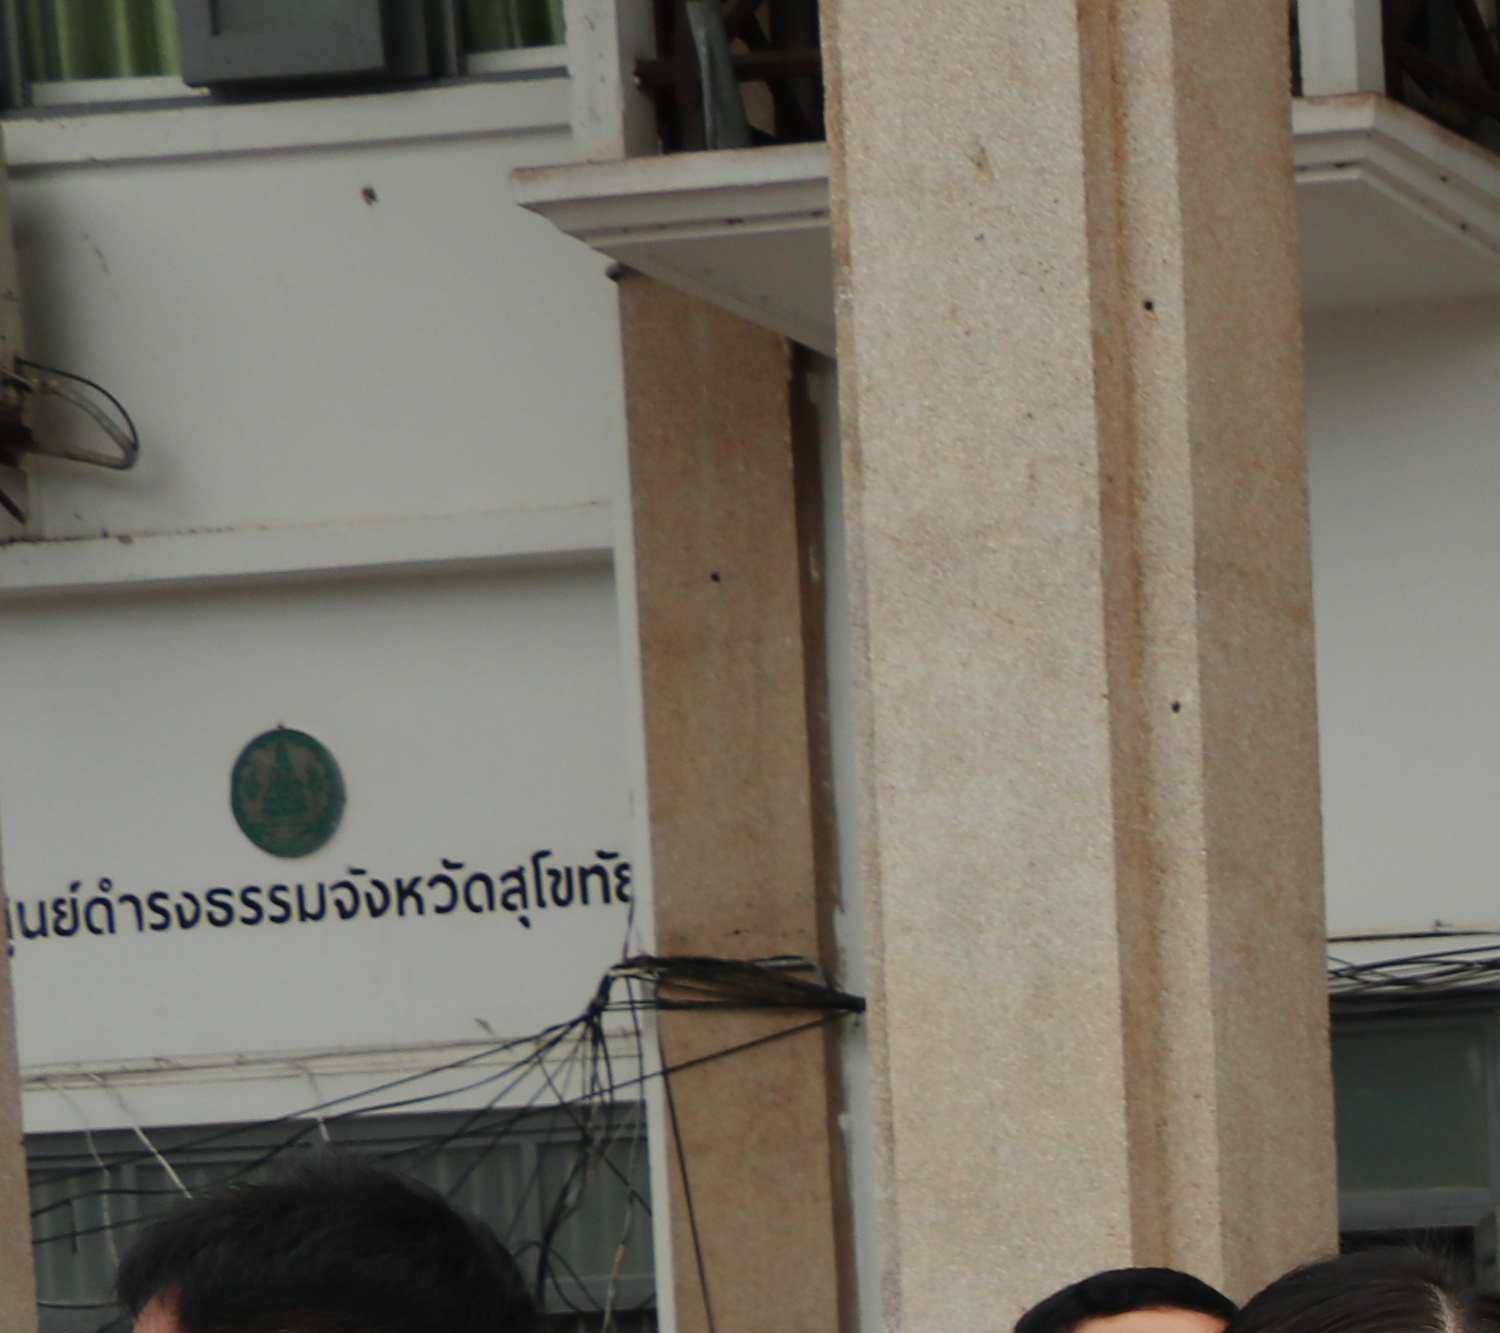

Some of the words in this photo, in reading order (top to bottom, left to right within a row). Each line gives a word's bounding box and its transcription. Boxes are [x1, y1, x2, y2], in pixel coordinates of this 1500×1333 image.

[4, 849, 633, 957] ูนย์ดำรงธรรมจังหวัดสุโขทัย
